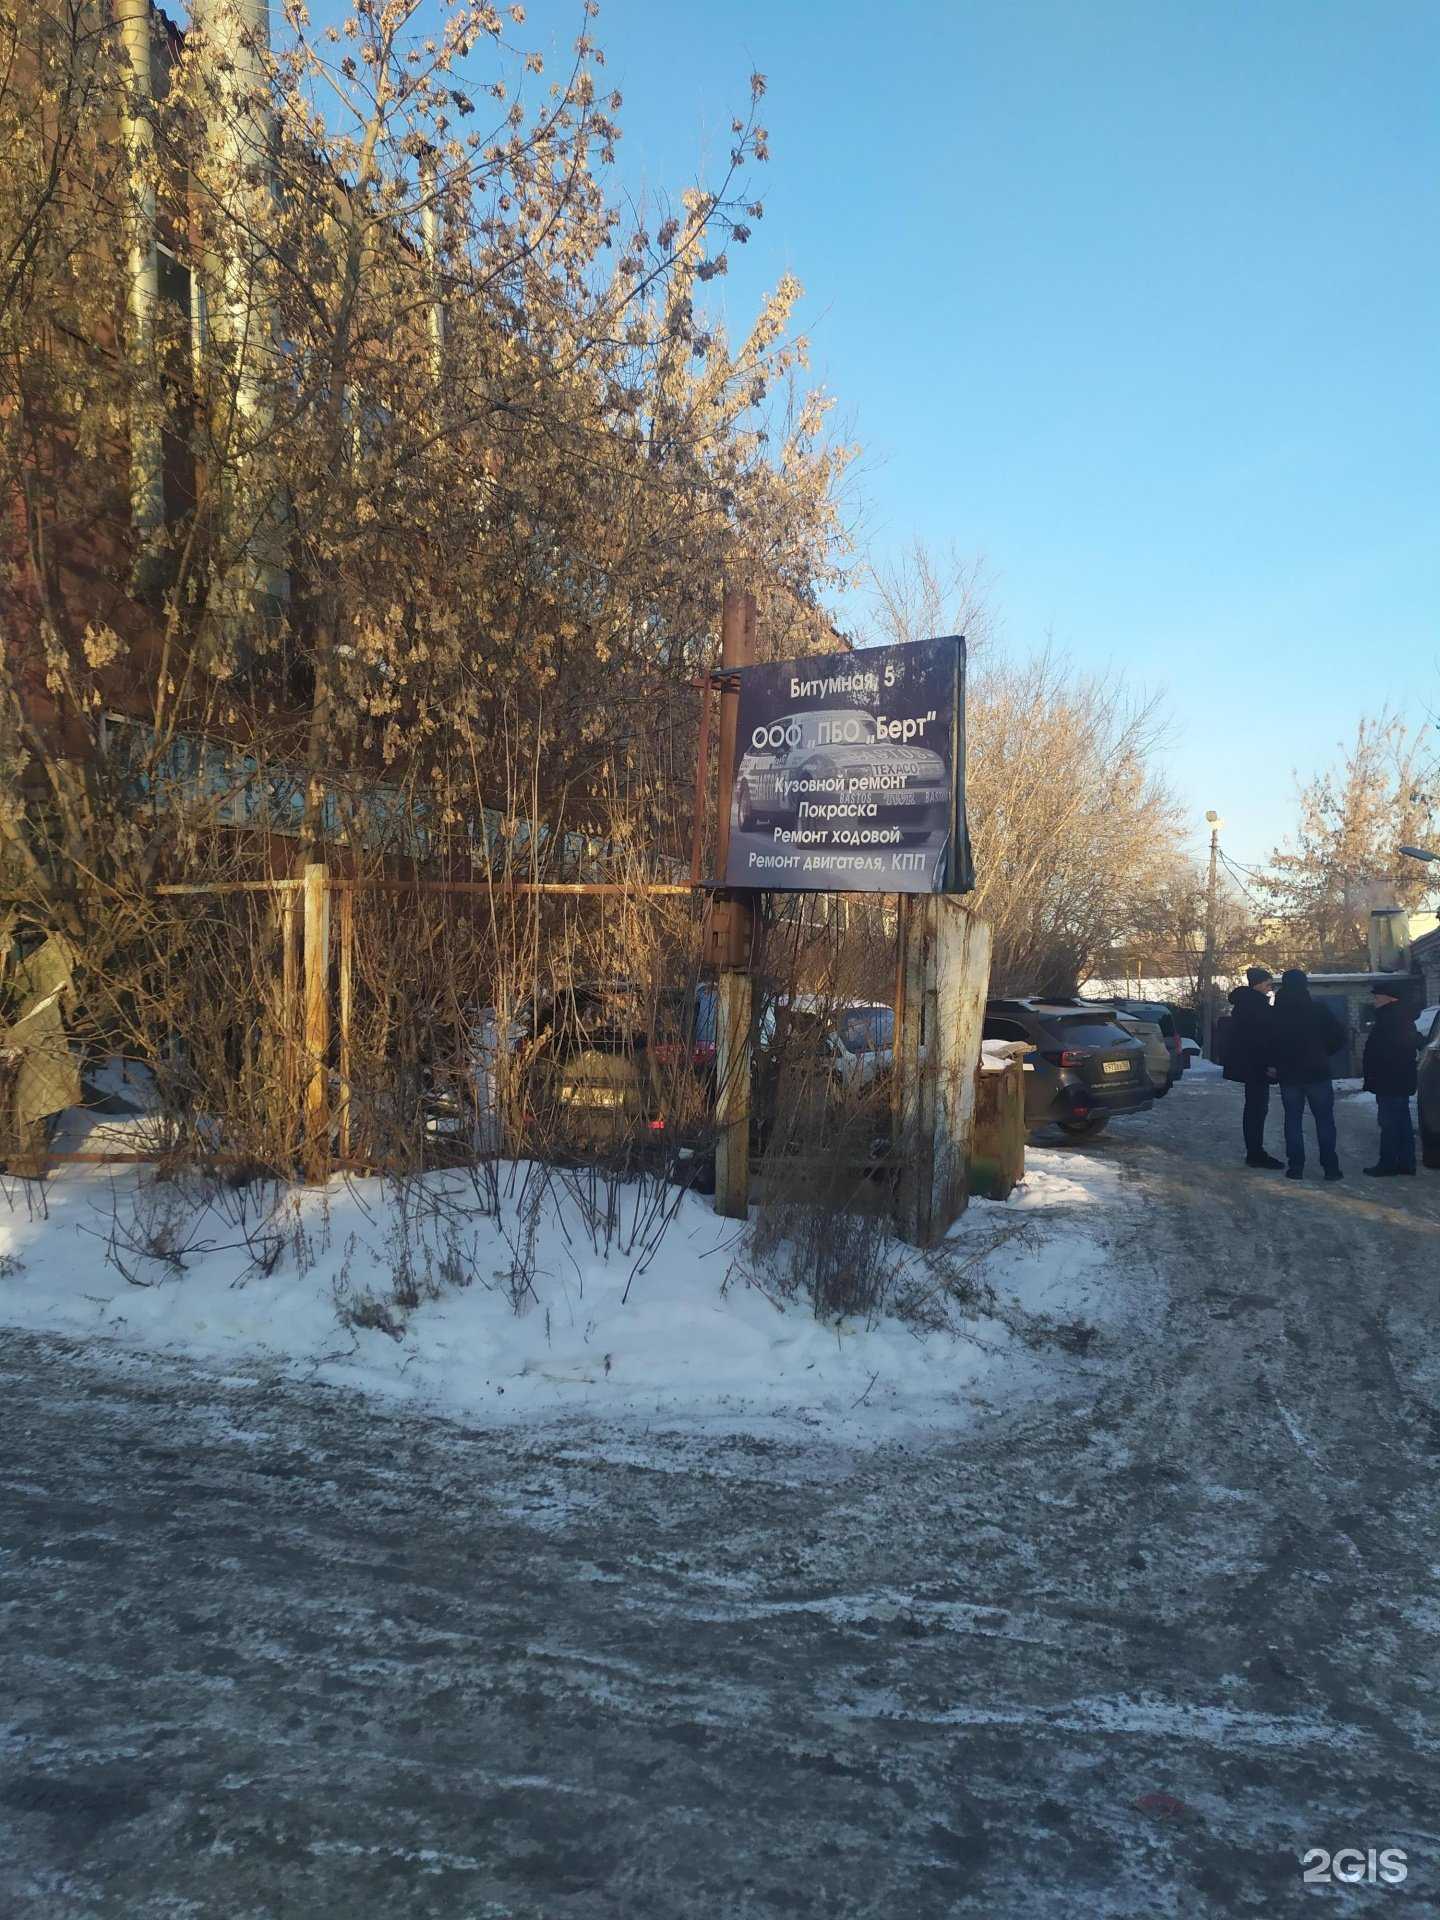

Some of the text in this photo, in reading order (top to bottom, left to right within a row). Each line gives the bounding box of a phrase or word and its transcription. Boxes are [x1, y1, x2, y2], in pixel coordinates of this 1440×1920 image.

[884, 665, 895, 687] 5
[873, 763, 918, 775] TEXACO
[775, 769, 845, 795] Кузовной
[848, 776, 907, 796] ремонт
[839, 792, 872, 804] BASTOS
[799, 802, 877, 820] Покраска
[774, 826, 900, 845] Ремонт ходовой
[749, 853, 926, 872] Ремонт двигателя, КПП
